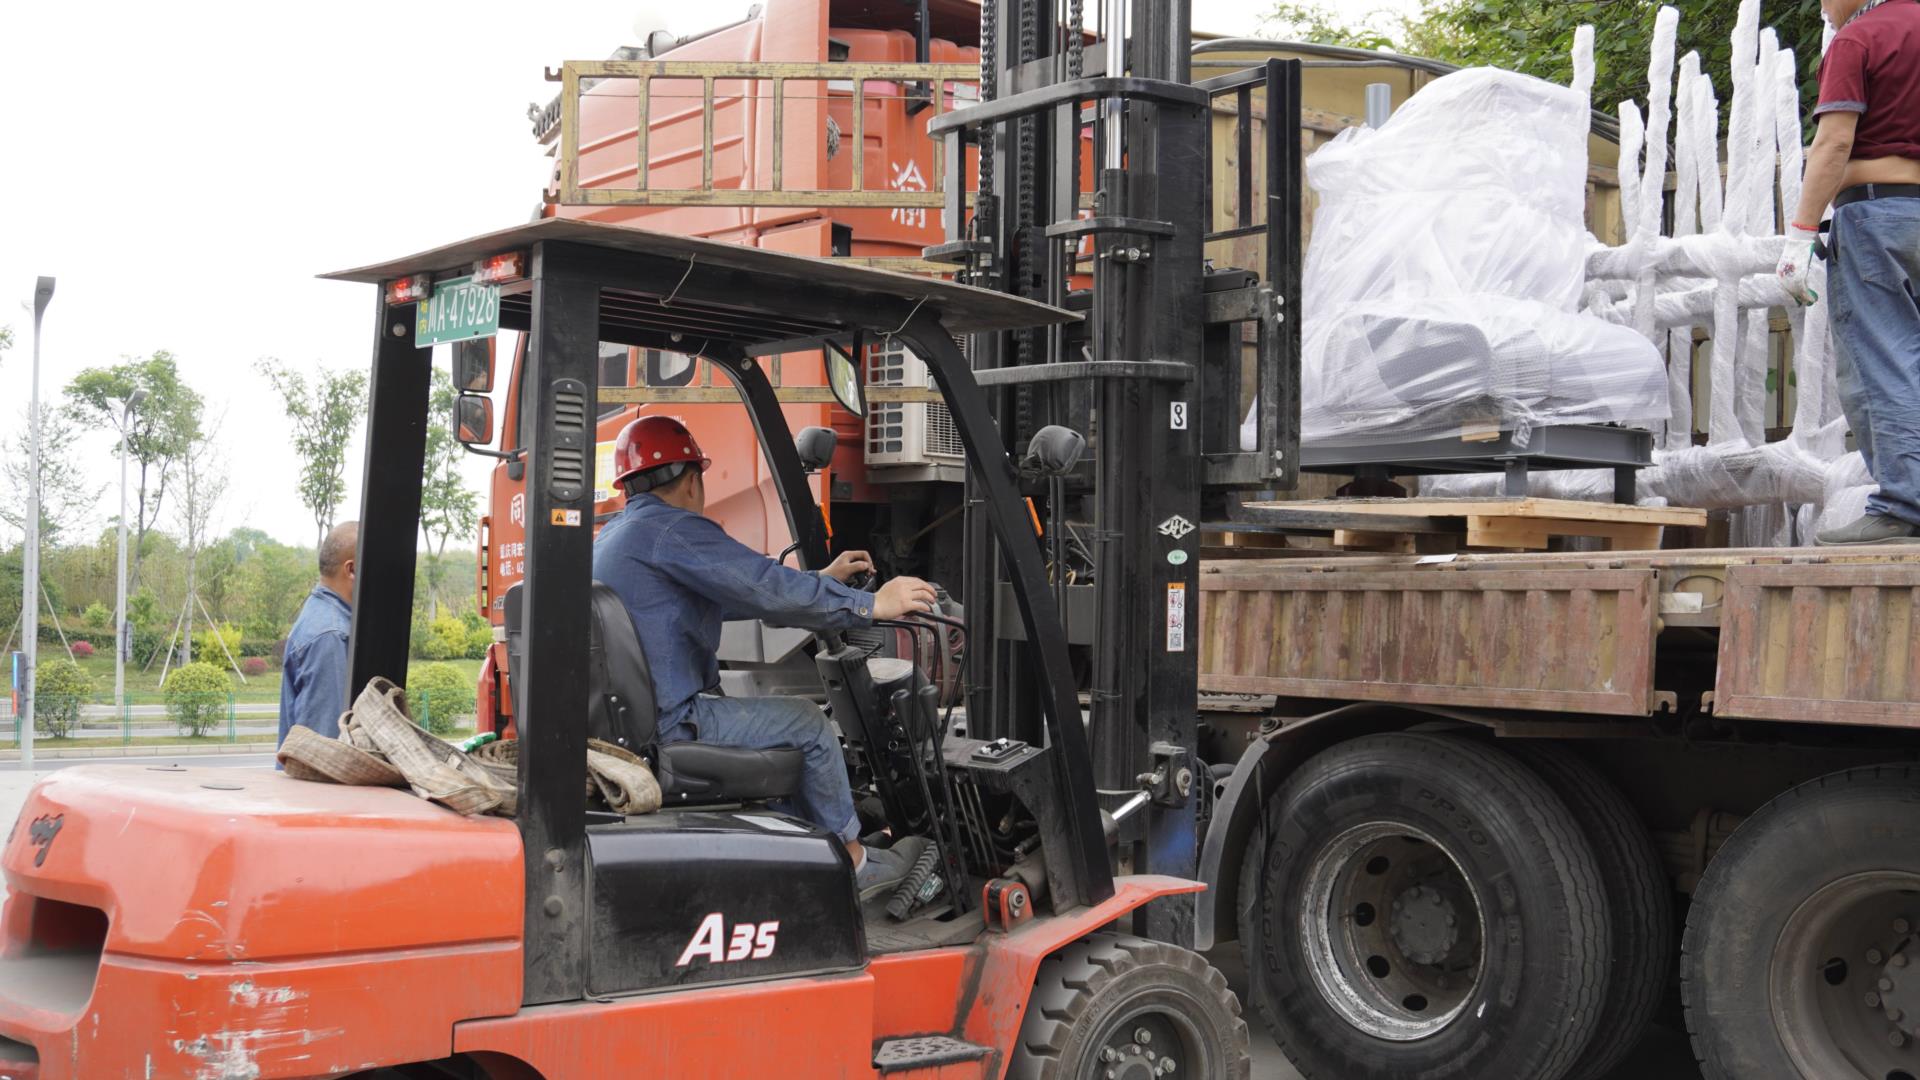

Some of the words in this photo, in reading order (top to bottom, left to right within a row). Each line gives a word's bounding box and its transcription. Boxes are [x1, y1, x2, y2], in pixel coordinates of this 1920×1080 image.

[499, 542, 525, 559] 重庆同宏
[674, 912, 779, 966] A35
